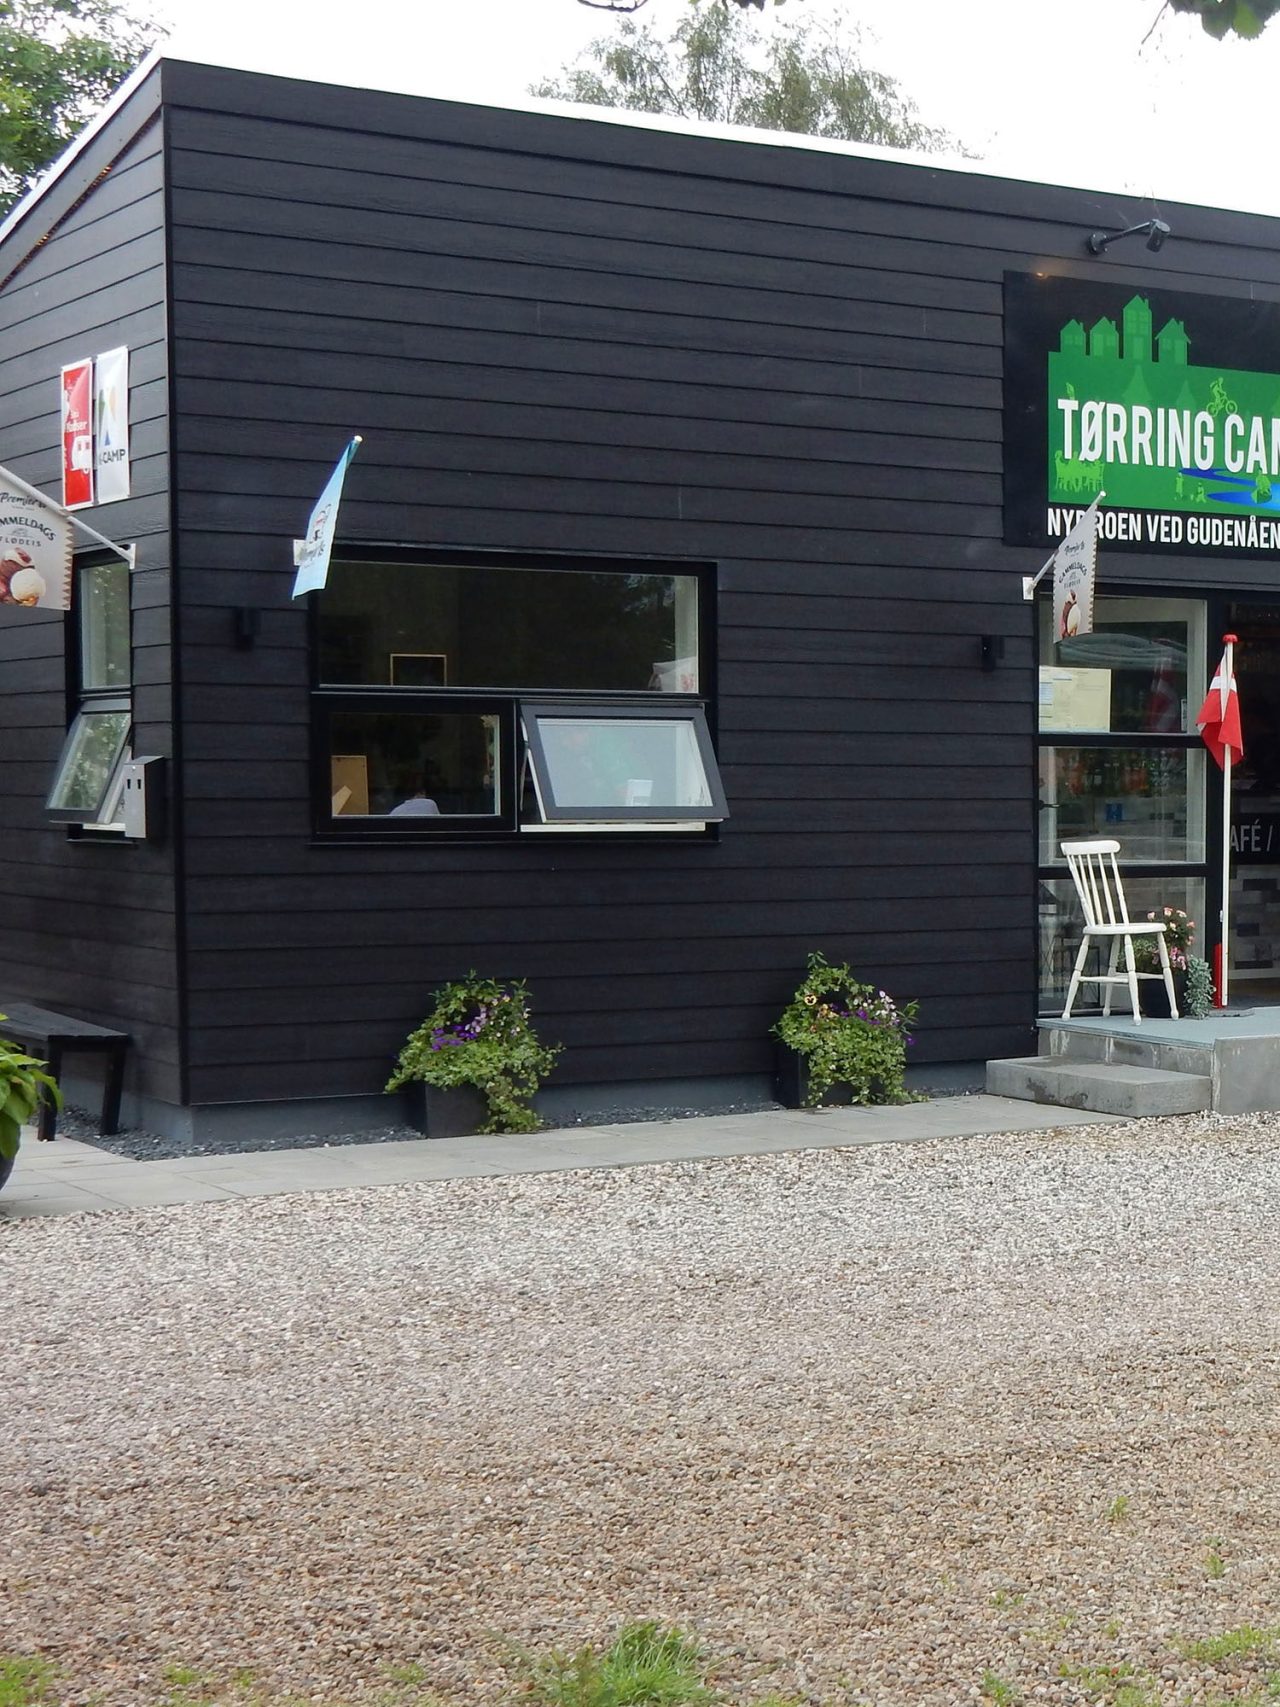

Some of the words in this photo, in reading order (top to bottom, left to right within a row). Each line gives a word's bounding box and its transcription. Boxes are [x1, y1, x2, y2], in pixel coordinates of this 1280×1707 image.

[1057, 398, 1215, 471] TØRRING
[1146, 514, 1183, 543] VED
[1229, 818, 1262, 852] AFÉ
